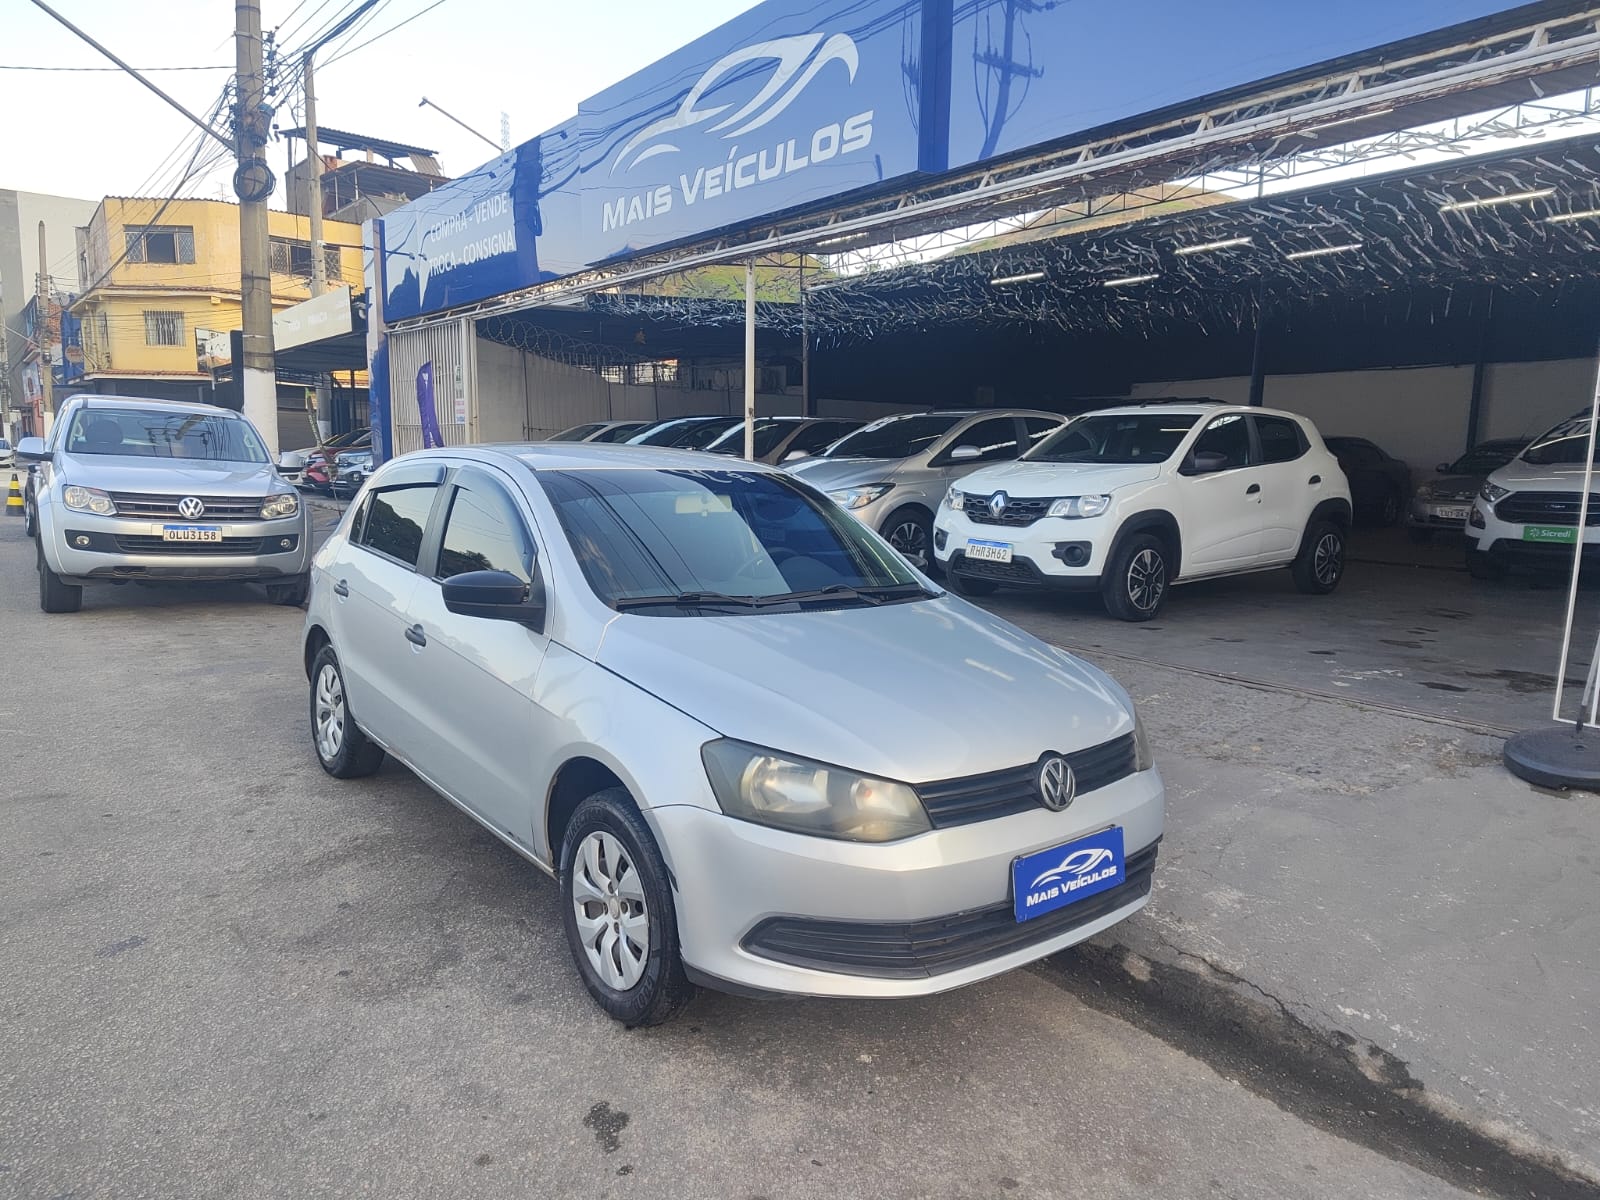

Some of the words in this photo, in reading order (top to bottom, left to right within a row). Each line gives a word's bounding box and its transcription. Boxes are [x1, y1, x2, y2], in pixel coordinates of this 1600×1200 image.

[602, 184, 672, 232] MAIS
[680, 110, 874, 206] VEÍCULOS
[430, 210, 467, 242] COMPRA
[474, 192, 507, 224] VENDE
[429, 251, 457, 277] TROCA
[464, 230, 515, 265] CONSIGNA
[969, 545, 1008, 560] RHR3H62
[1541, 529, 1570, 538] Sicredi
[1026, 887, 1059, 907] MAIS
[1060, 865, 1118, 893] VEÍCULOS
